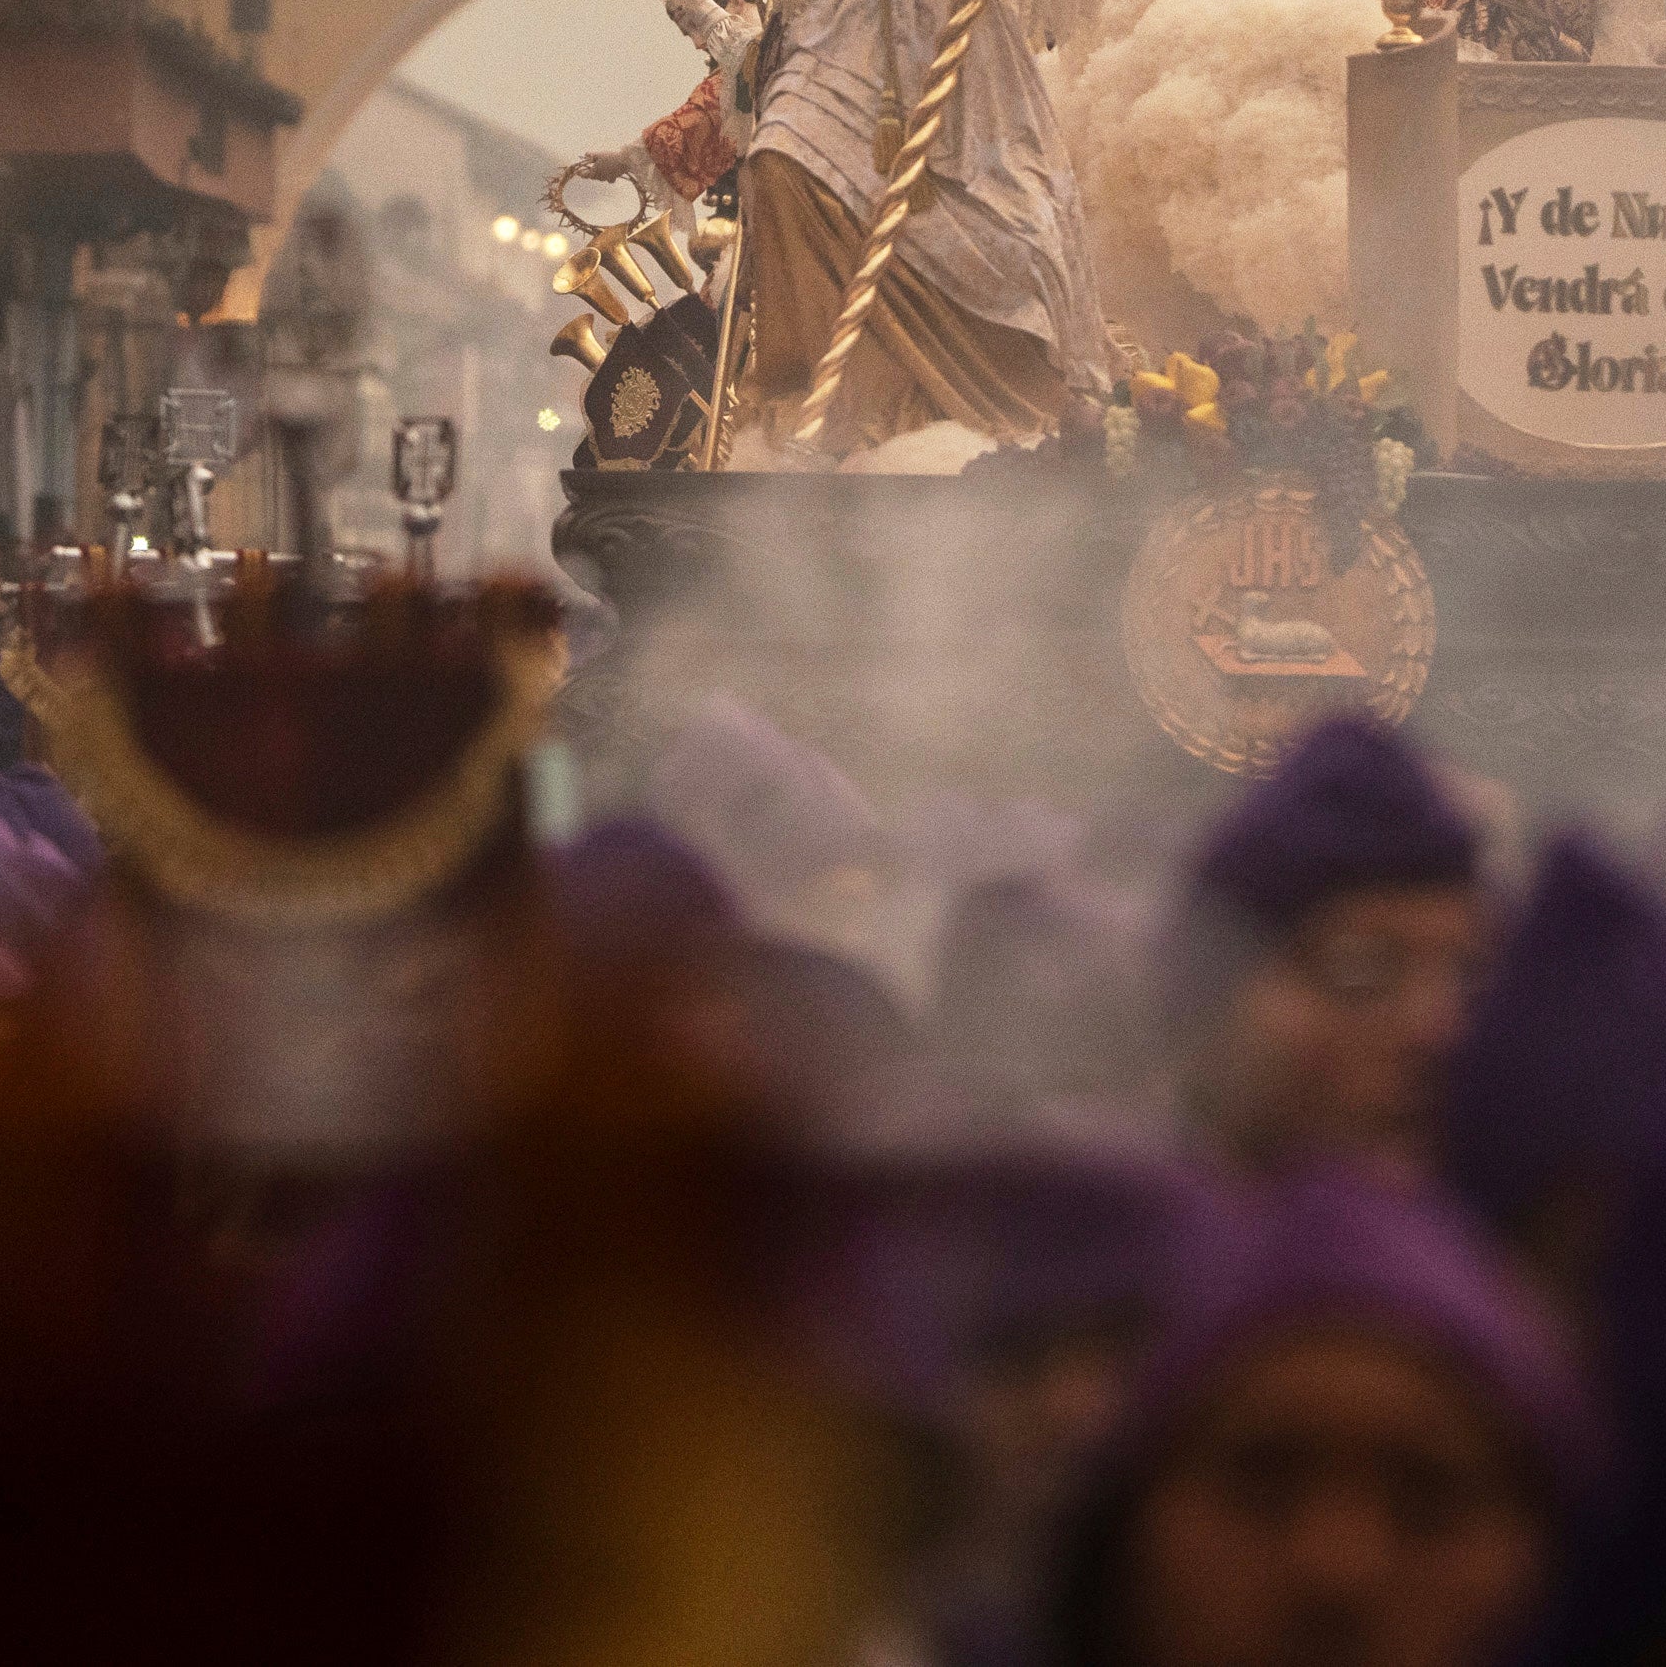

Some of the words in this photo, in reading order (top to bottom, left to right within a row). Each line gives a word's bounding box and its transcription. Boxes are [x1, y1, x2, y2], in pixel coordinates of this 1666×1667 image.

[1479, 187, 1528, 245] ¡Y
[1540, 187, 1600, 238] de
[1480, 262, 1650, 315] Vendrá
